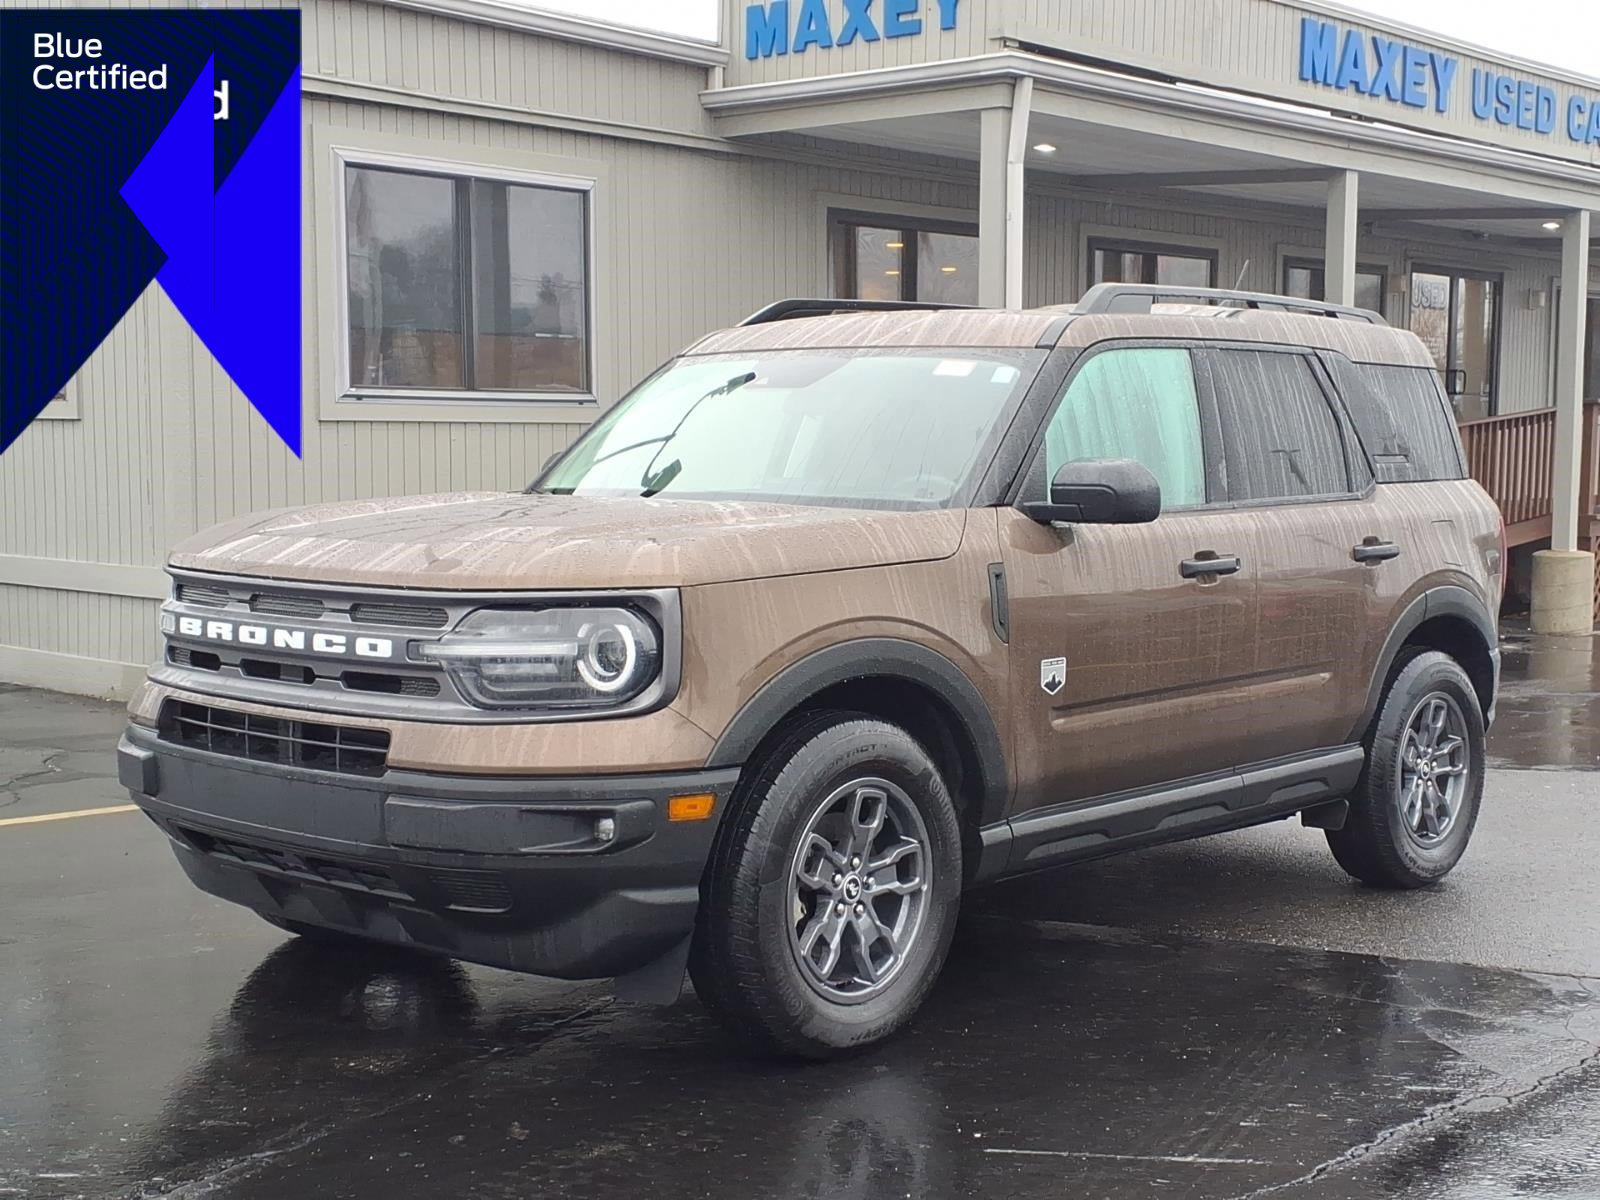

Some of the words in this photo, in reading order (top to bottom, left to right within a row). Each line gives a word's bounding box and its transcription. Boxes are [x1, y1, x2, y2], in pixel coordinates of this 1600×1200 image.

[745, 0, 958, 60] MAXEY
[1299, 17, 1458, 113] MAXEY
[1472, 68, 1557, 134] USED
[1411, 280, 1447, 311] USED
[179, 616, 393, 658] BRONCO
